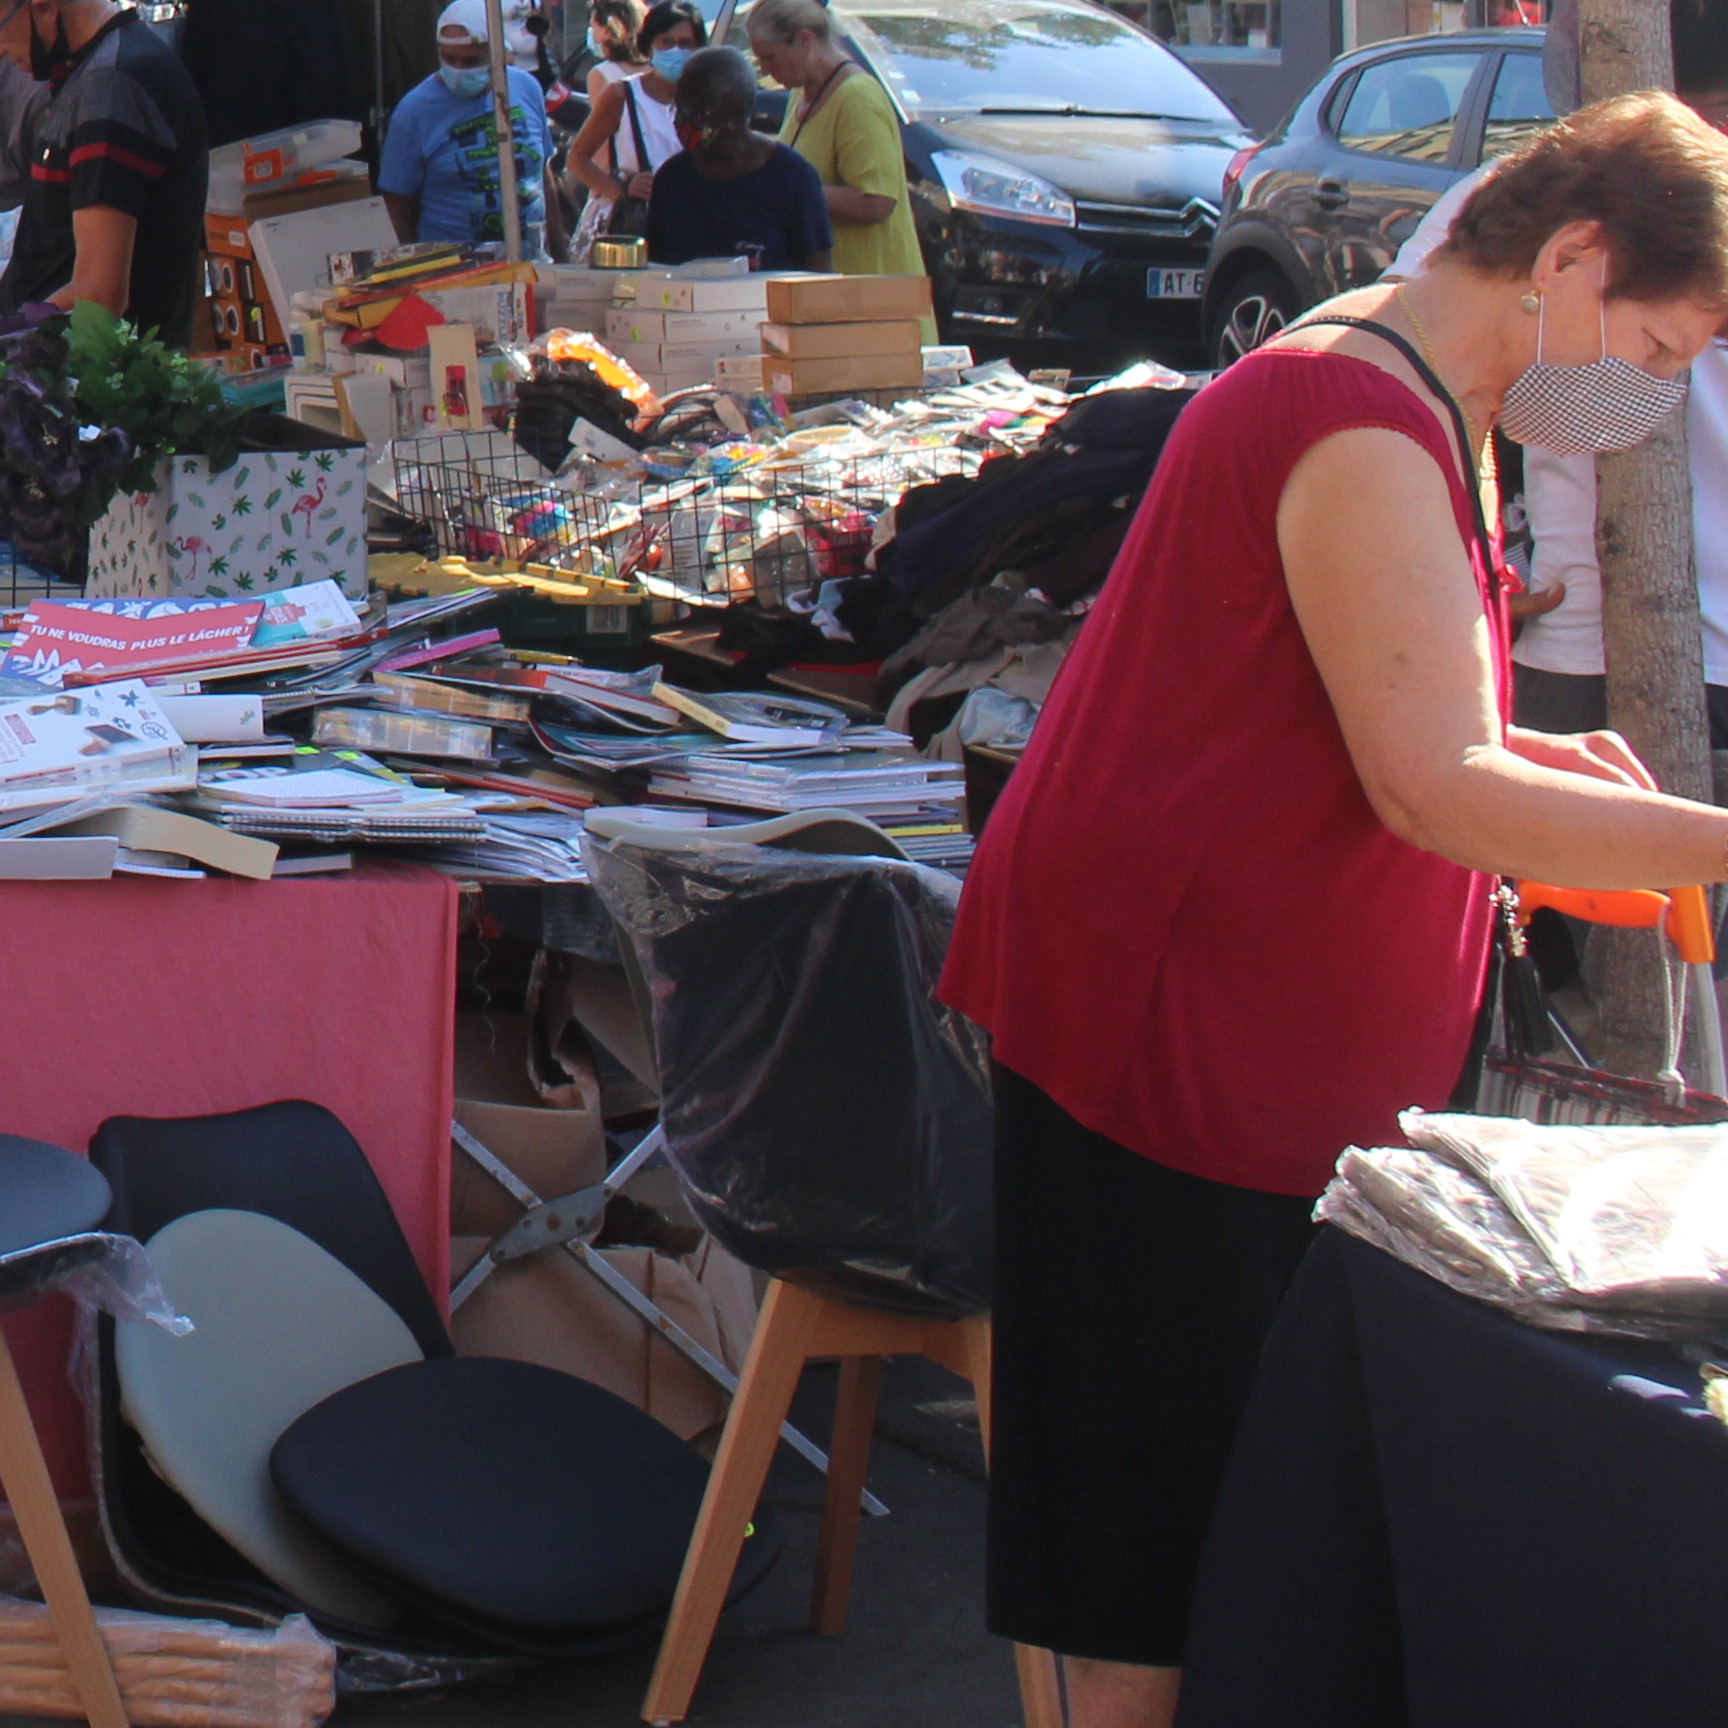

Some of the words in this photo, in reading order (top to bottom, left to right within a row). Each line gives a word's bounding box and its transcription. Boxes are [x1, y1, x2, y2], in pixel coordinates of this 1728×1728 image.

[1164, 272, 1205, 295] AT-6
[29, 624, 47, 637] TU
[48, 627, 66, 640] NE
[67, 630, 127, 652] VOUDRAS
[130, 636, 167, 651] PLUS
[169, 632, 184, 646] LE
[187, 624, 241, 644] LÂCHER
